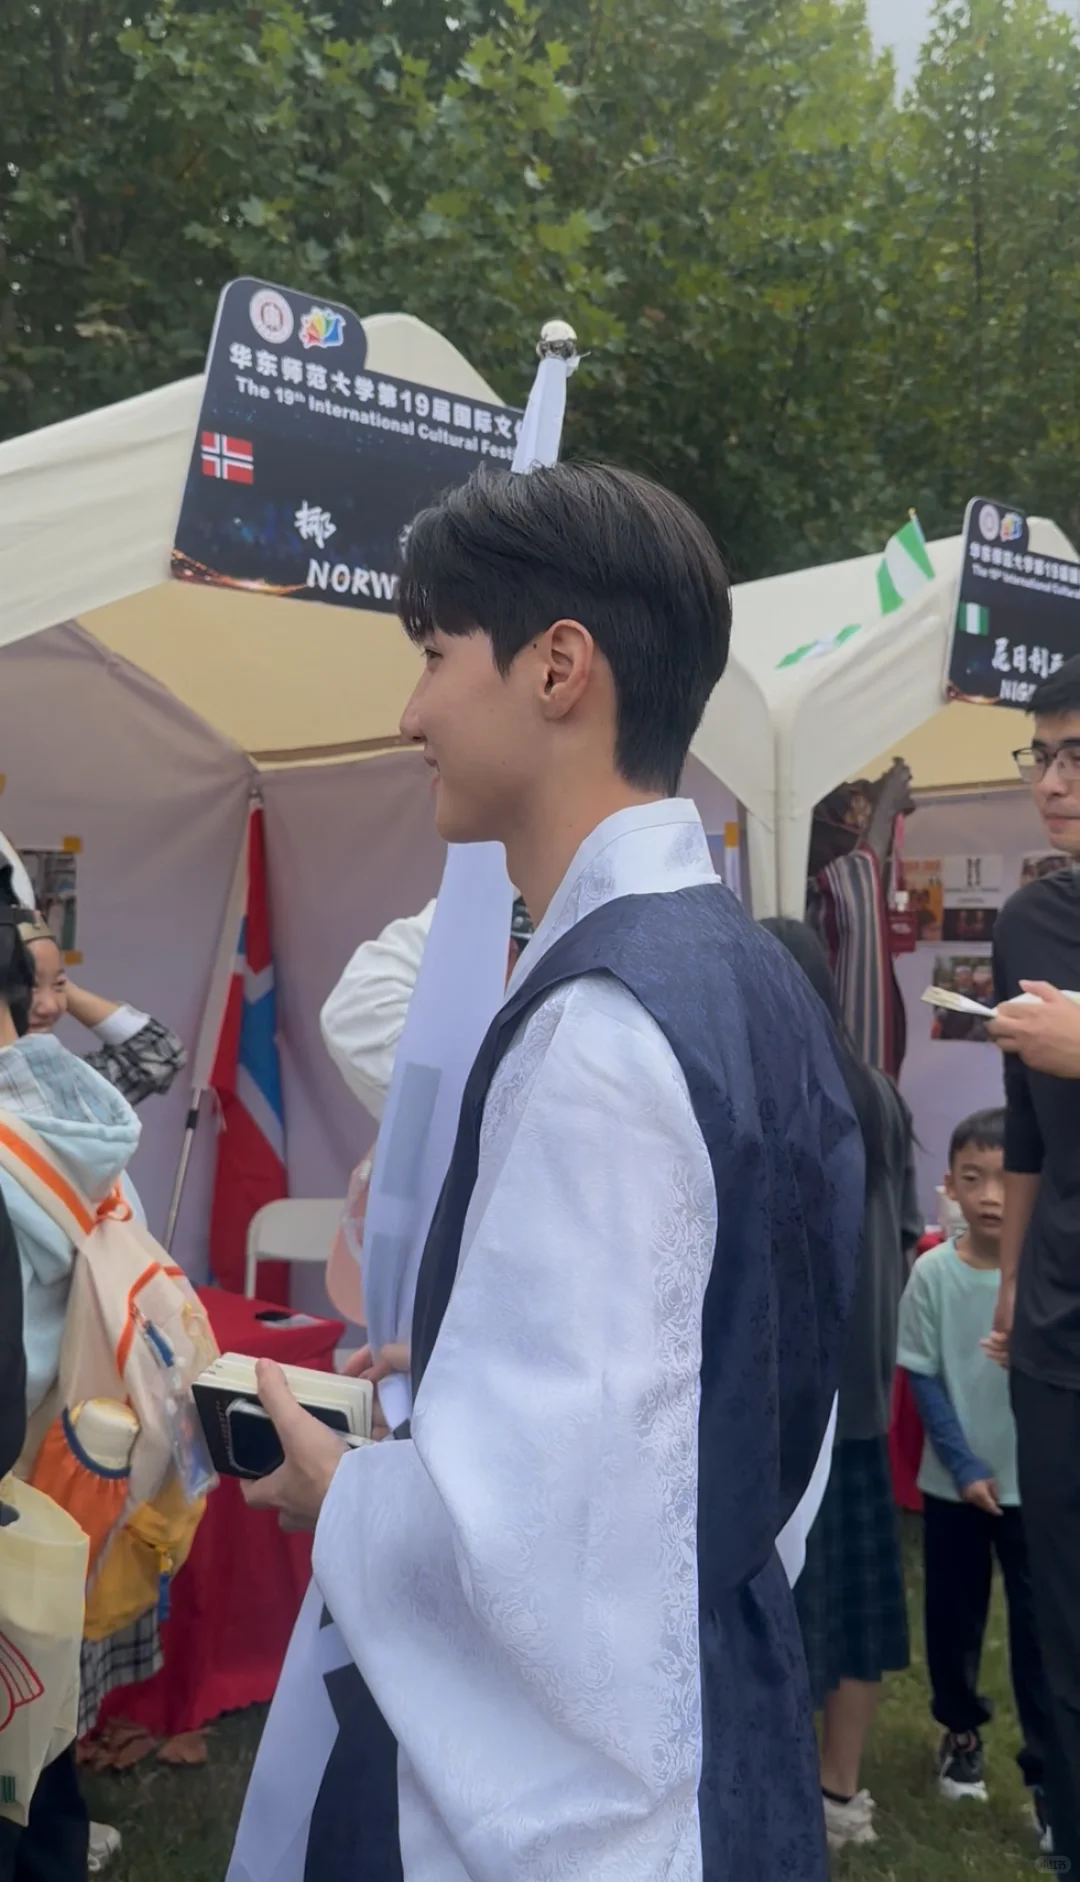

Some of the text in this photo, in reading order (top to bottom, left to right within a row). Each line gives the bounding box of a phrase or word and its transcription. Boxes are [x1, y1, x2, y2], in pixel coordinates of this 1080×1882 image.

[235, 375, 271, 400] The
[274, 386, 306, 406] 19th
[308, 394, 415, 437] International
[417, 422, 479, 452] Cultural
